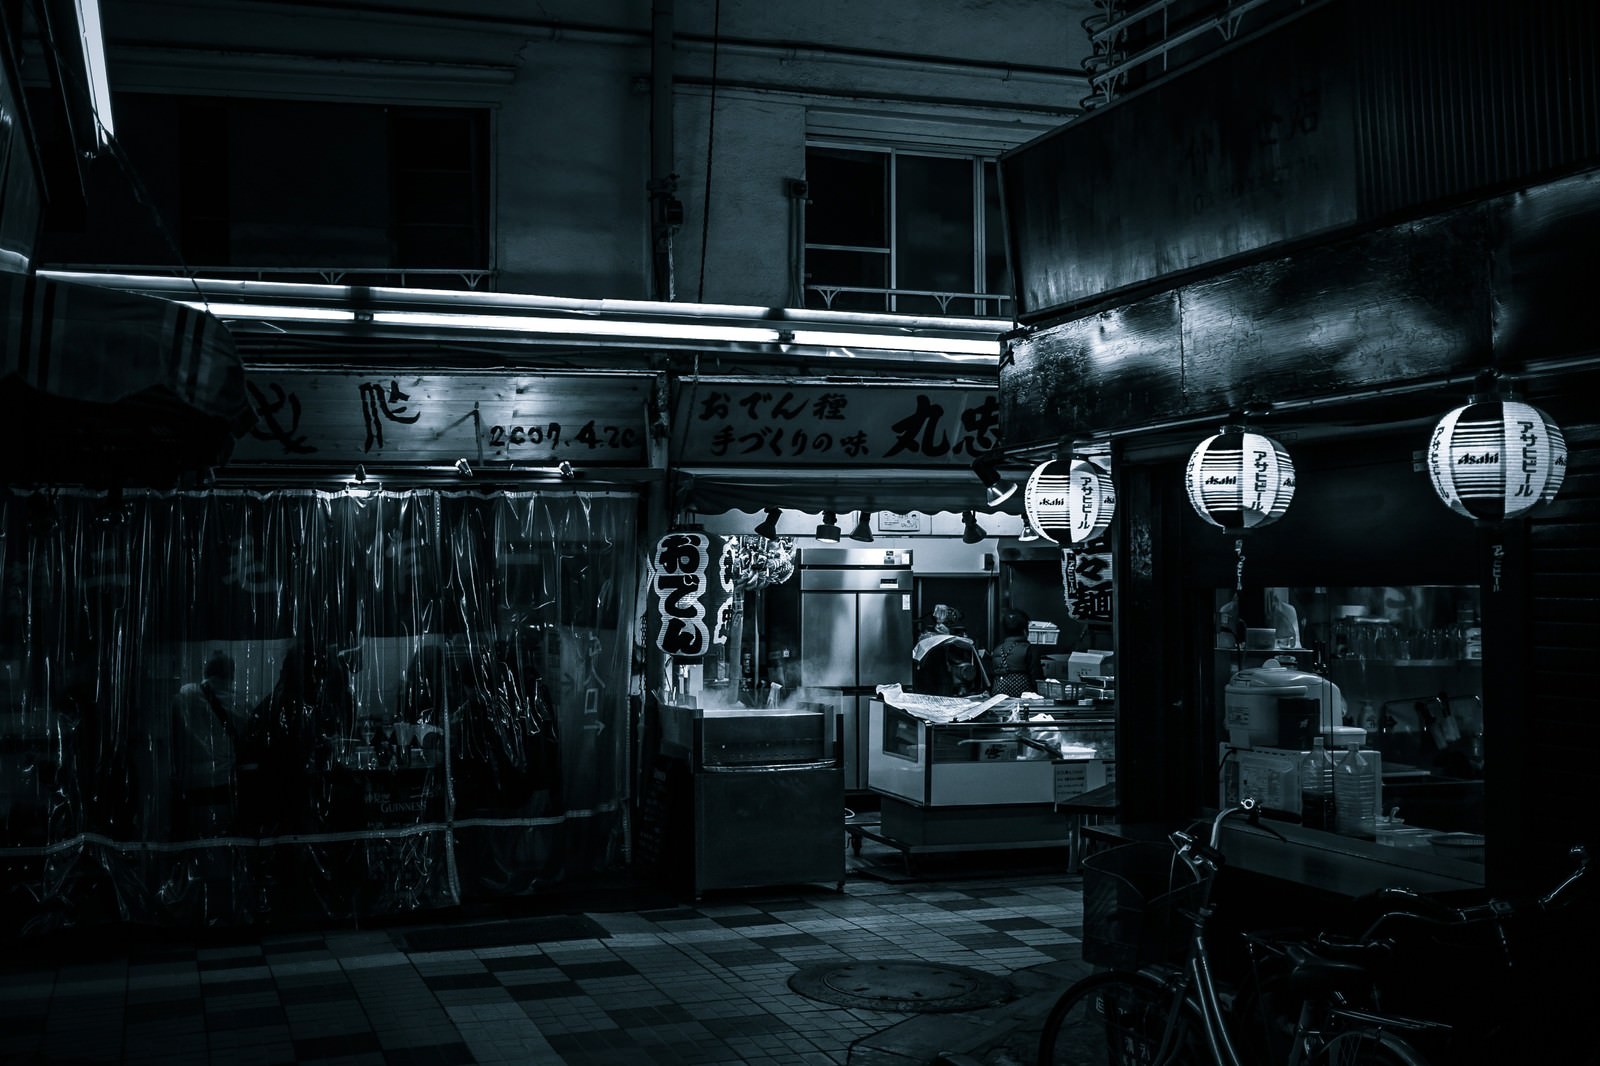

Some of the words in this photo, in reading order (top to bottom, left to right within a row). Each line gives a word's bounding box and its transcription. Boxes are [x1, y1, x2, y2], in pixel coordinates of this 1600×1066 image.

[699, 391, 848, 420] おでん種
[711, 425, 868, 457] 手づくりの味
[1458, 452, 1499, 465] Asahi
[1514, 421, 1538, 497] アサヒビール
[1205, 475, 1237, 485] Asahi
[1251, 450, 1269, 511] アサヒビール
[1039, 497, 1065, 506] Asahi
[1077, 476, 1094, 530] アサヒビール
[657, 534, 703, 654] おでん
